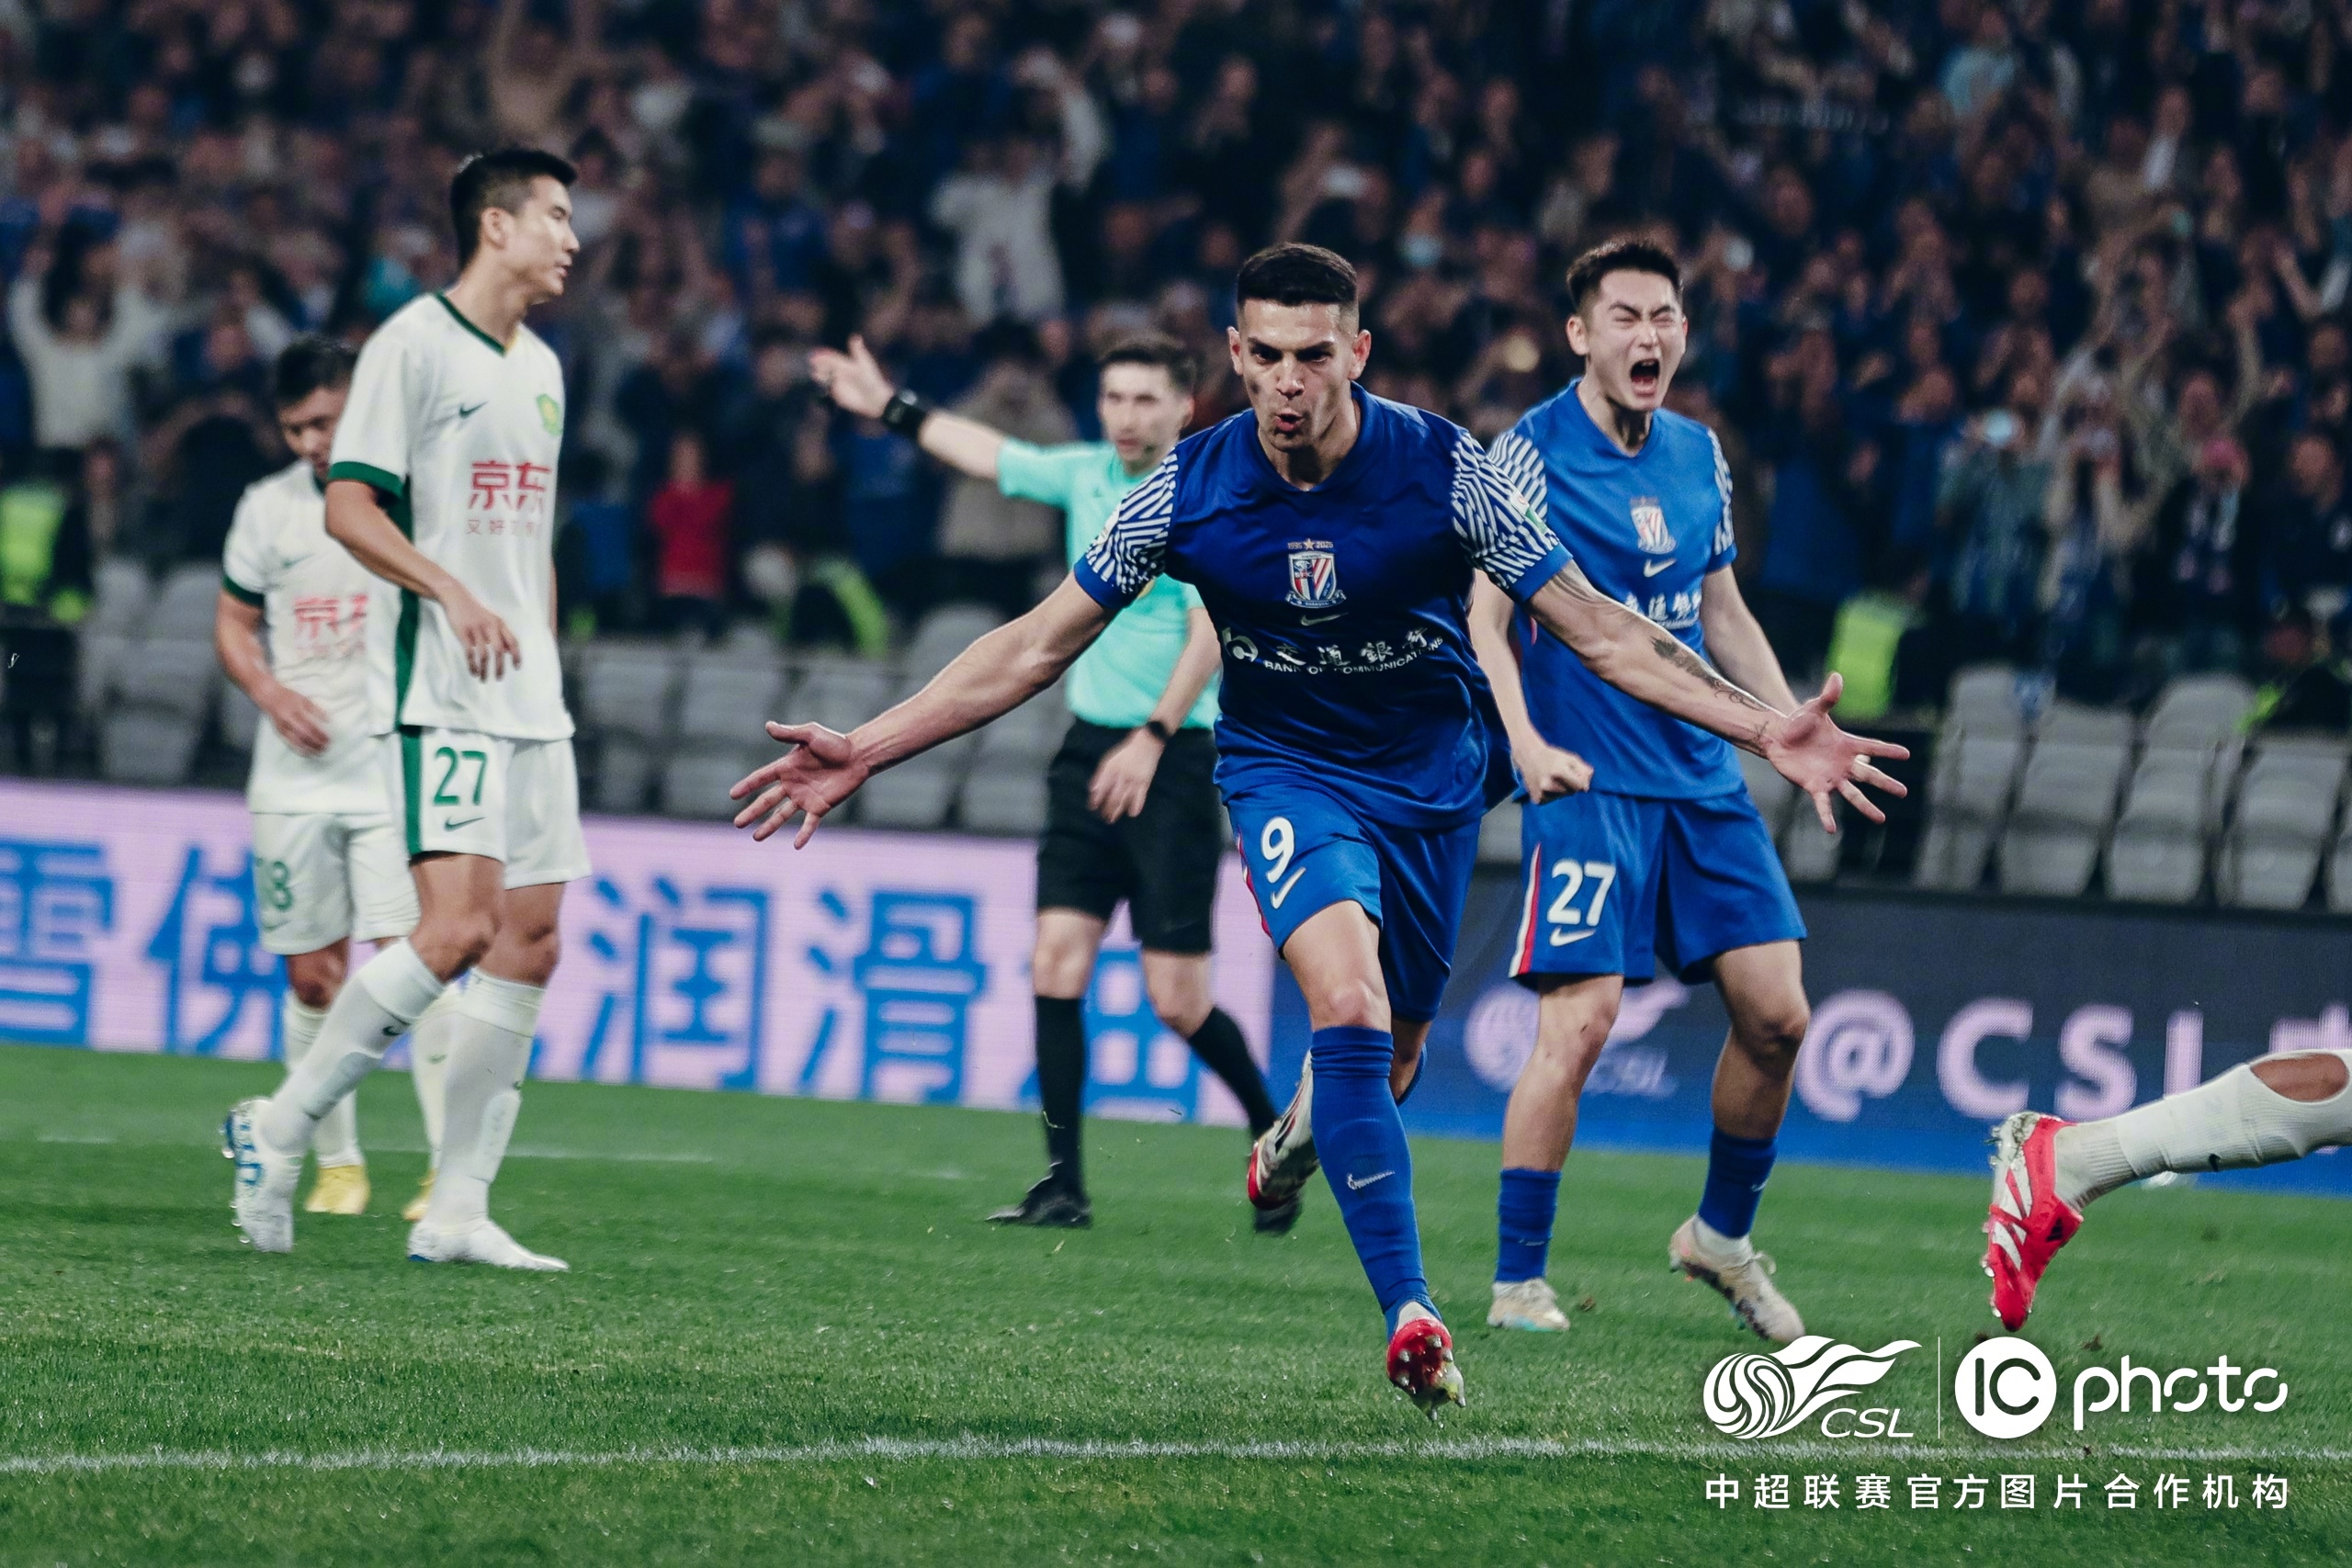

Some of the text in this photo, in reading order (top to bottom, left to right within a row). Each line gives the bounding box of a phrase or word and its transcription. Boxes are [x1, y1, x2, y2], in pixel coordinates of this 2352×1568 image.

[468, 460, 551, 513] 京东
[1316, 541, 1334, 549] 2025
[434, 746, 488, 807] 27
[1261, 816, 1295, 885] 9
[1546, 859, 1617, 927] 27
